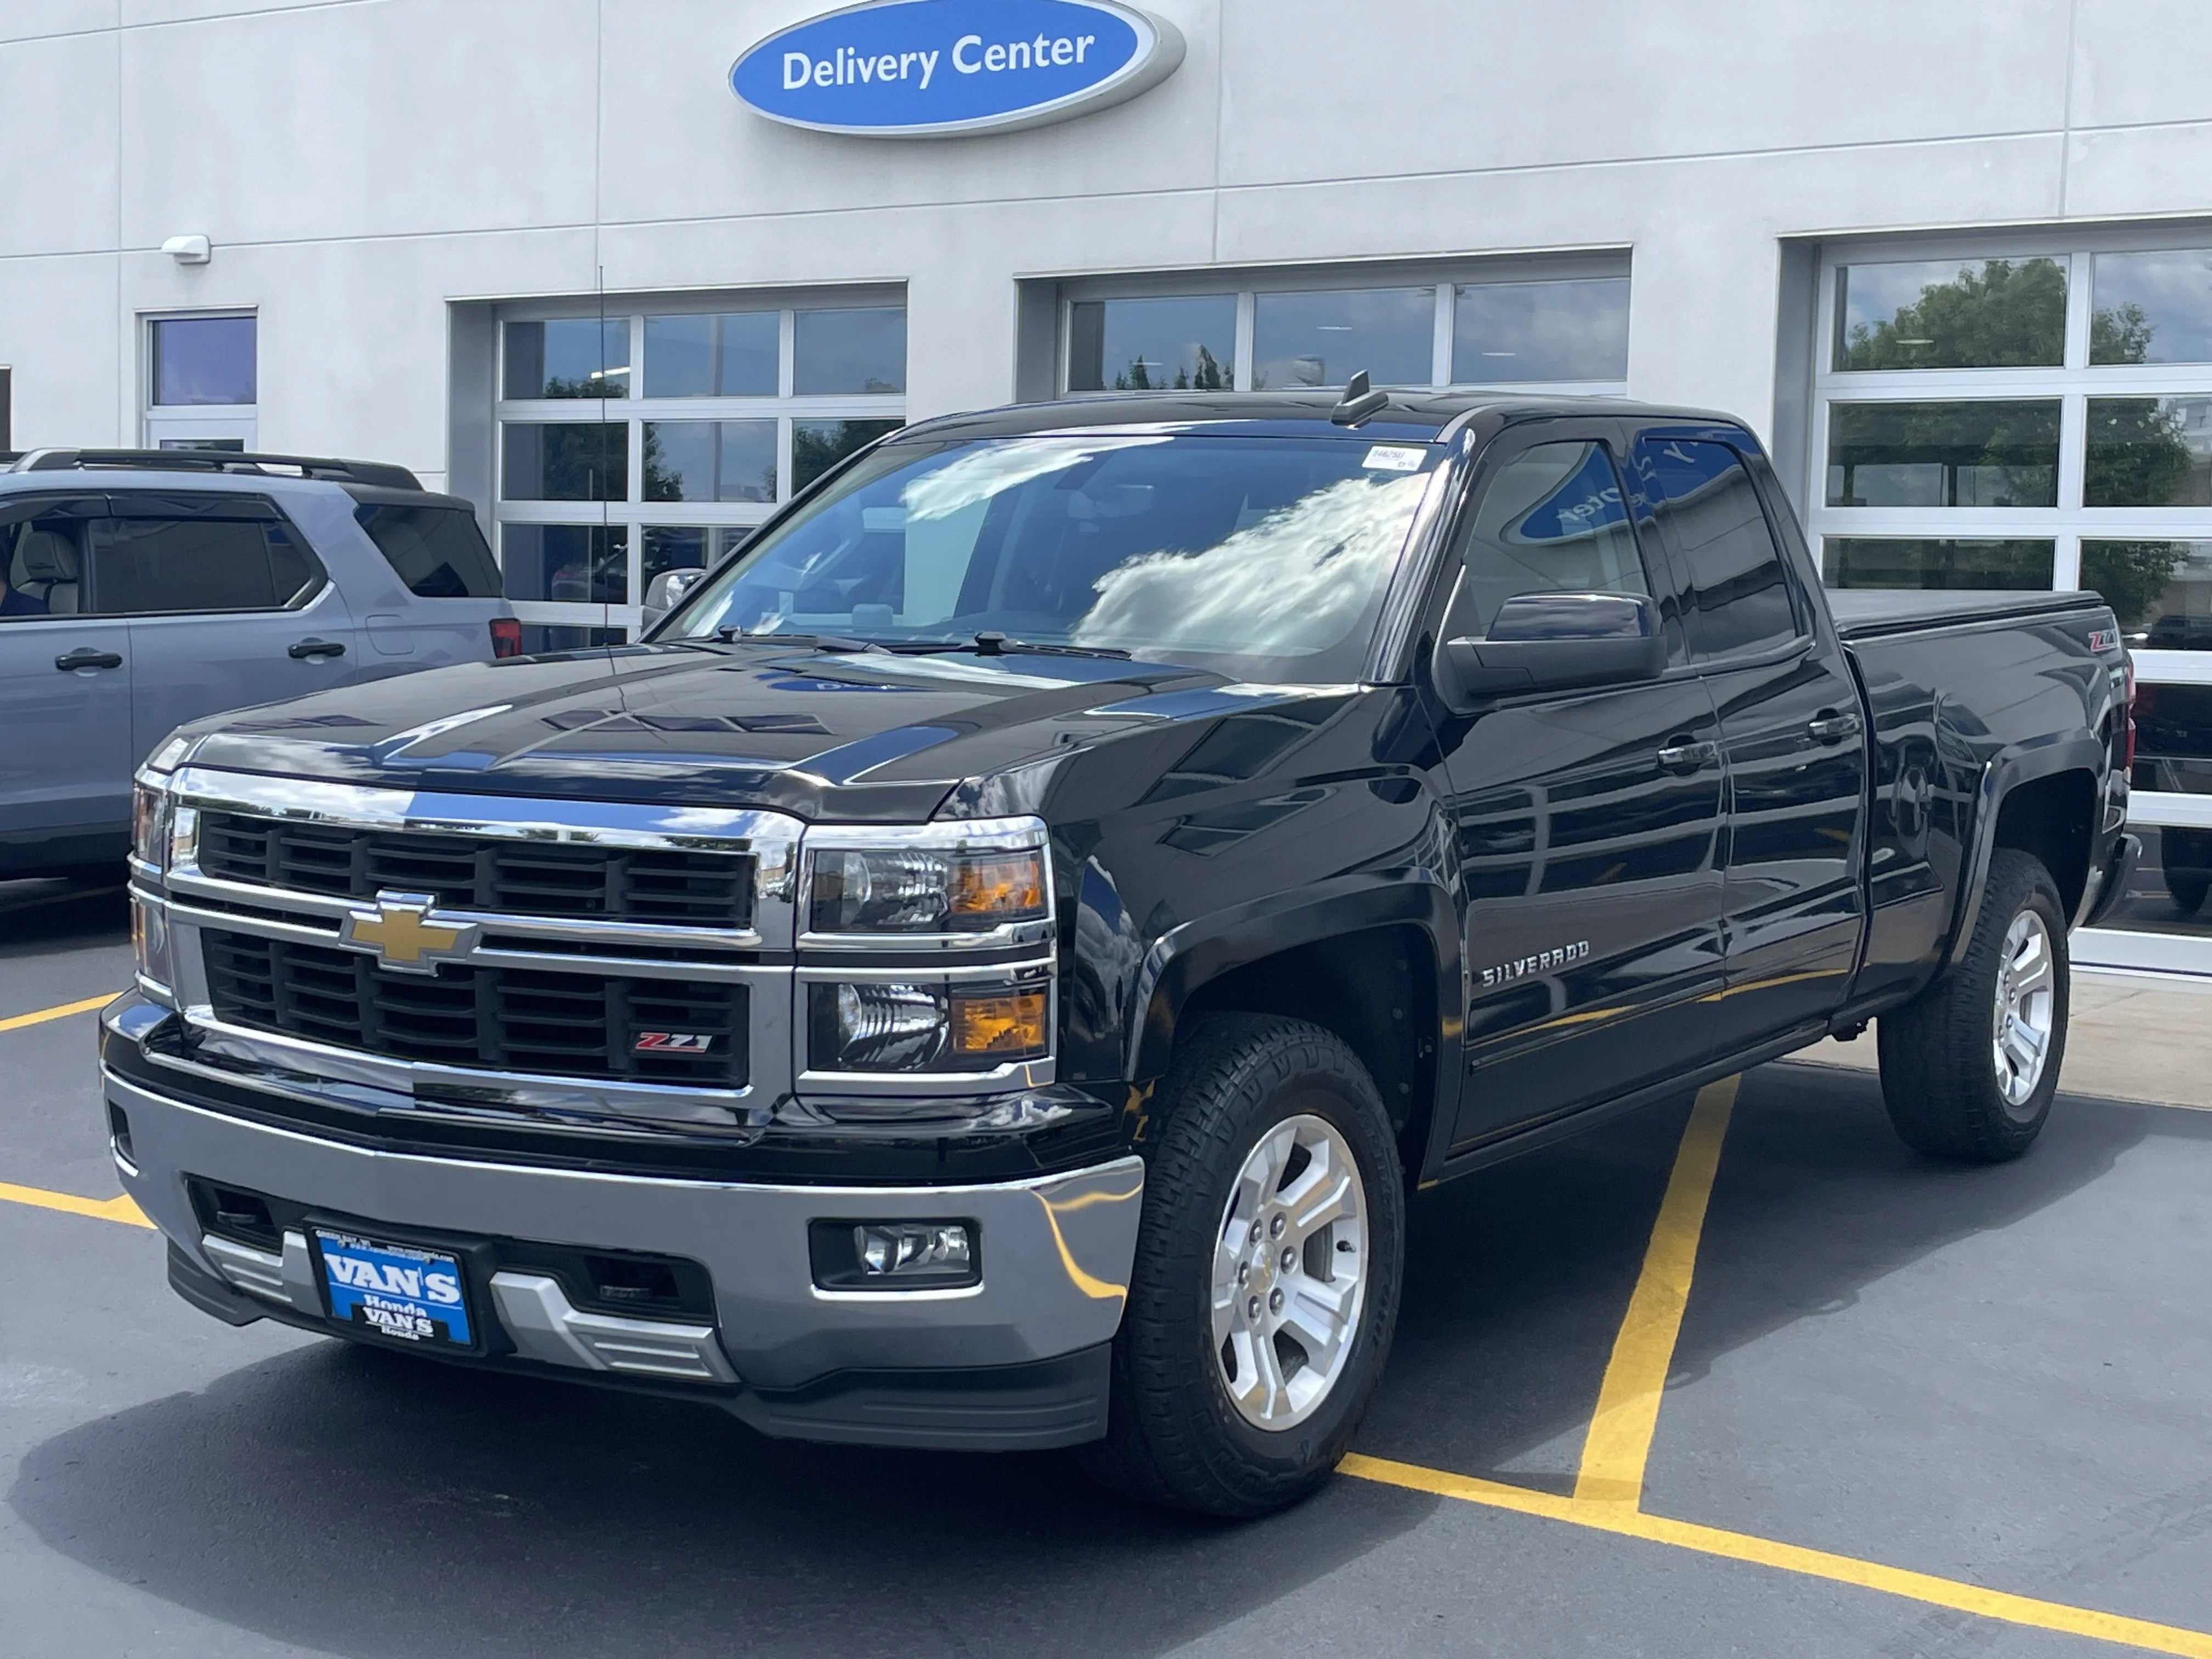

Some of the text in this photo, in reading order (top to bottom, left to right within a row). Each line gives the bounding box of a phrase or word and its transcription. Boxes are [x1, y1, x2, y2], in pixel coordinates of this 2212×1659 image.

[782, 33, 1096, 90] Delivery Center
[1482, 939, 1590, 988] SILVERADO
[635, 1031, 713, 1053] Z71
[323, 1252, 461, 1304] VAN'S
